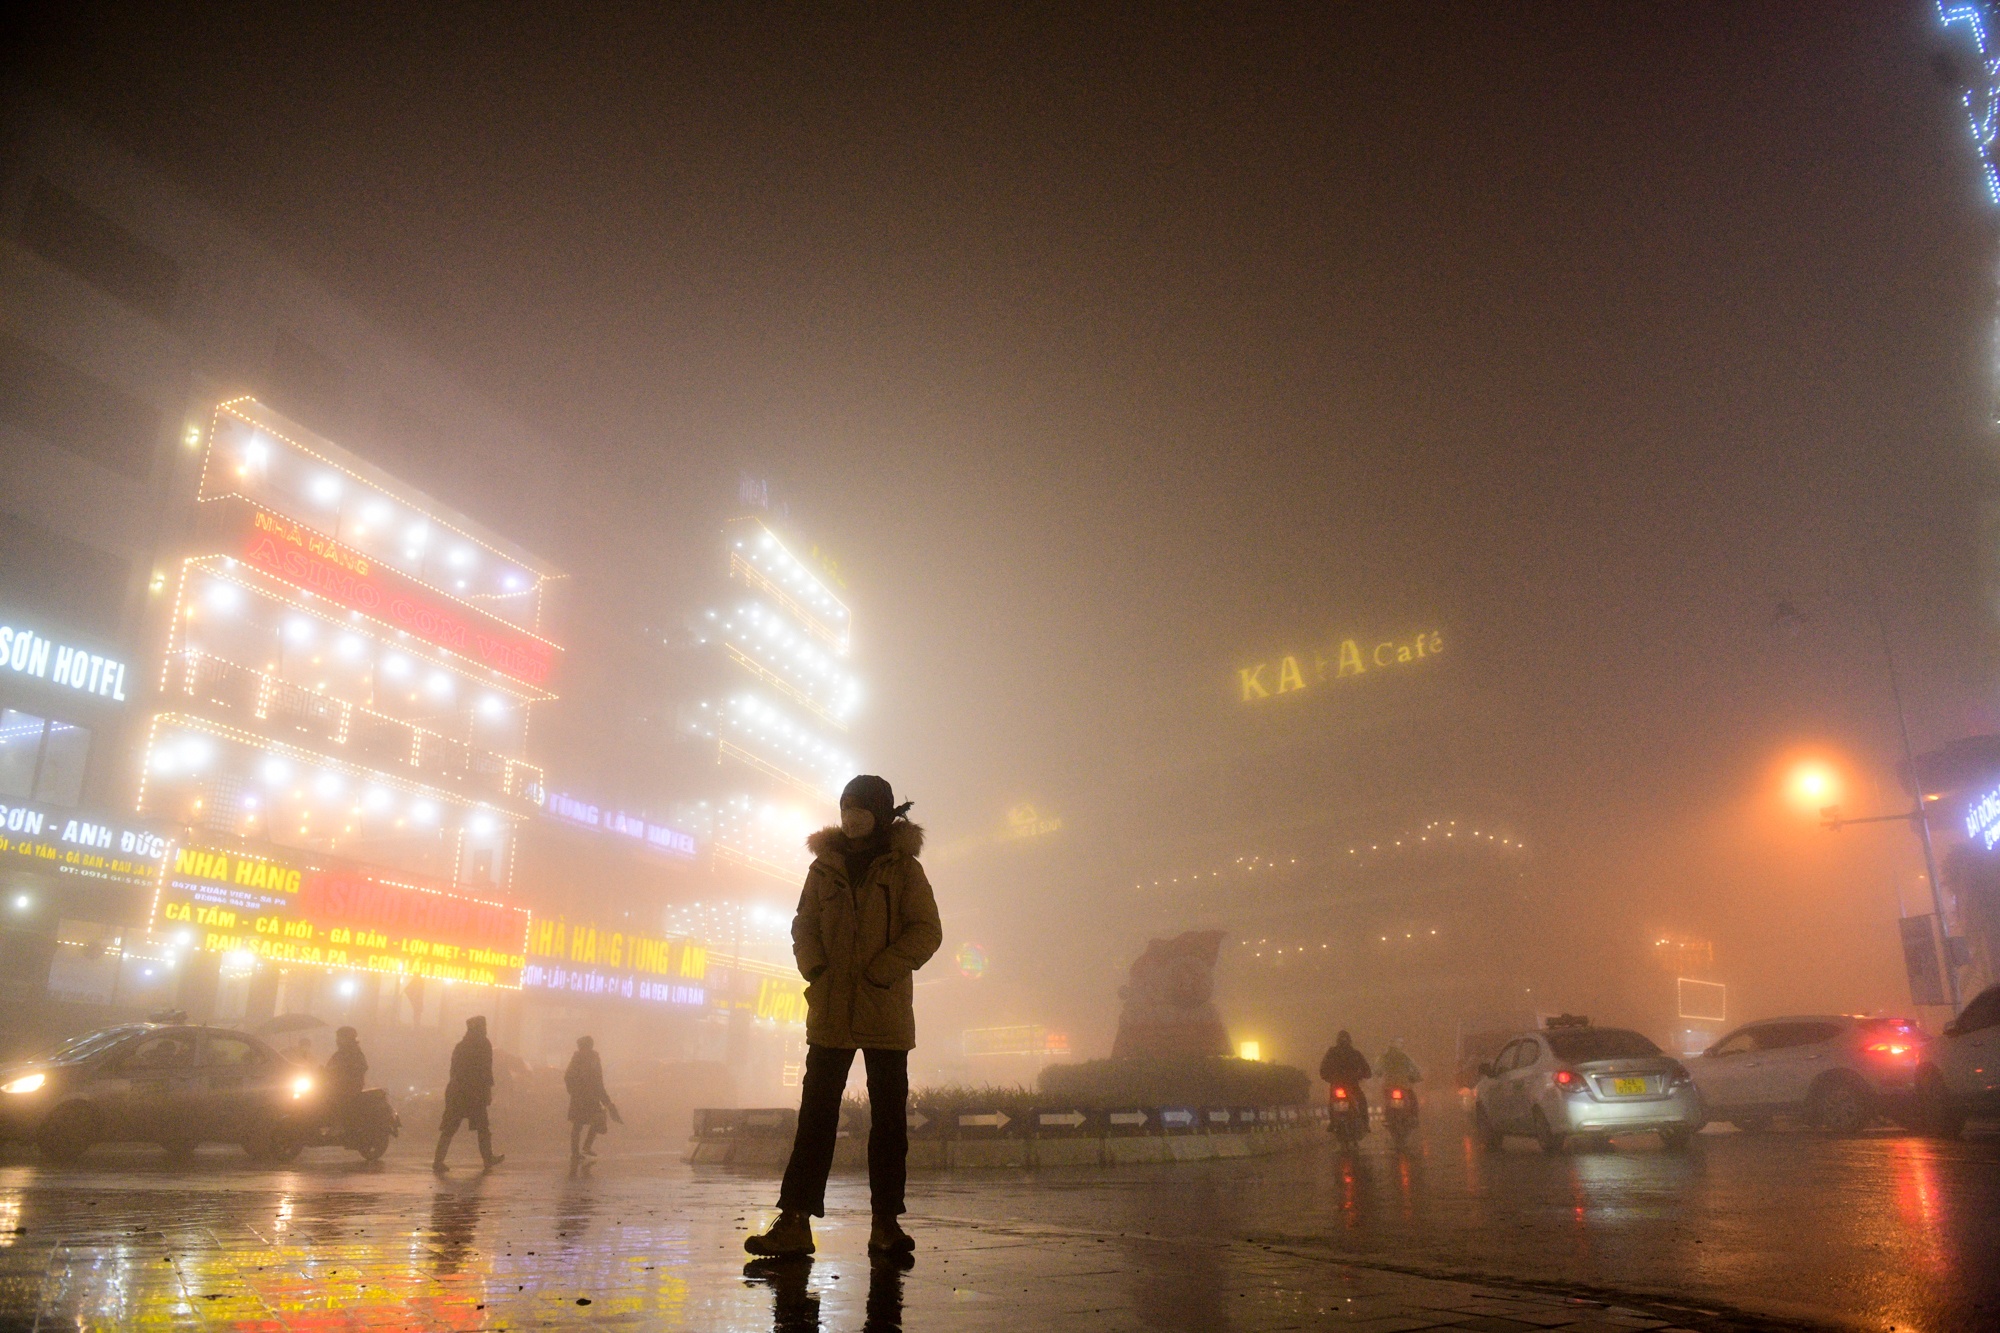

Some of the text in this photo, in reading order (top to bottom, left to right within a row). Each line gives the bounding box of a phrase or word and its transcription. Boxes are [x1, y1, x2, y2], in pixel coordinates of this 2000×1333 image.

[255, 511, 369, 577] NHÀ HÀNG
[249, 538, 380, 609] ASIMO
[0, 626, 125, 702] SƠN HOTEL
[1237, 631, 1444, 701] KAA Café
[0, 804, 165, 859] SƠN ANH ĐỨC
[174, 848, 302, 894] NHÀ HÀNG
[165, 902, 192, 922] CÁ
[255, 915, 280, 935] CÁ
[330, 927, 351, 945] GÀ
[401, 938, 429, 956] LỢN
[626, 931, 670, 976] TÙNG
[672, 938, 706, 980] ÂM
[757, 977, 797, 1021] Liên
